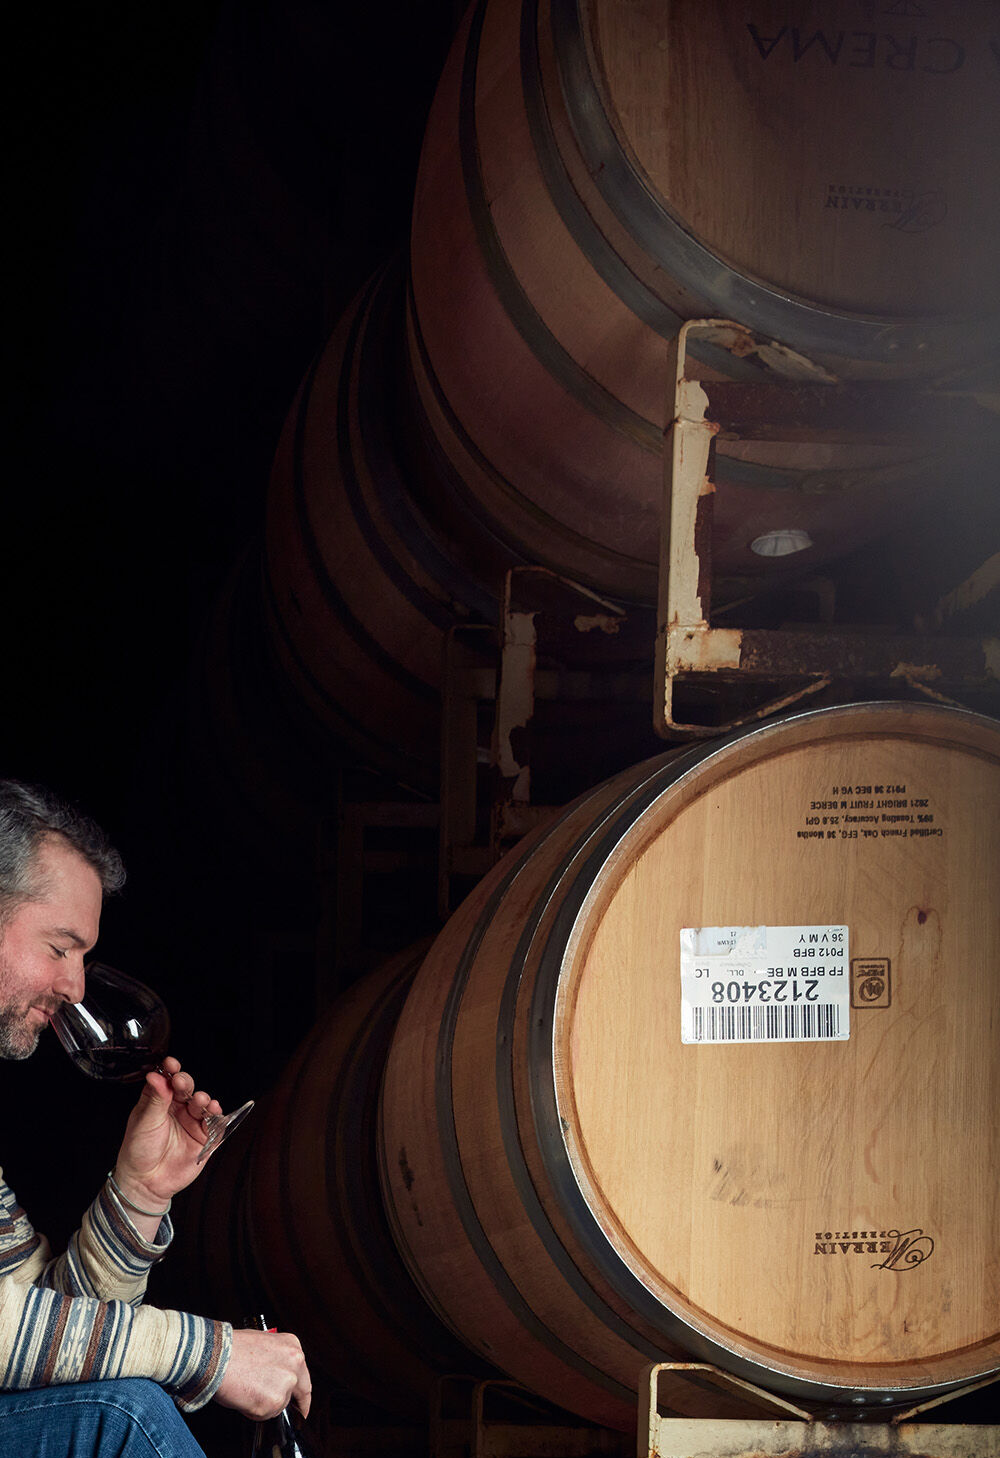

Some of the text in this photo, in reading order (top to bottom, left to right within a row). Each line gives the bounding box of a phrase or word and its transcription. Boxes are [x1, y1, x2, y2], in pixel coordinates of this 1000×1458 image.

[746, 24, 965, 74] CREMA
[833, 787, 838, 795] H
[811, 799, 928, 809] 2021 BRIGHT FRUIT M BERCE
[797, 831, 824, 839] Months
[881, 829, 907, 837] French
[910, 828, 943, 837] Certified
[799, 933, 843, 942] 36 V M Y
[793, 947, 843, 957] P012 BFB
[695, 966, 843, 978] FP BFB M BE LC
[711, 980, 819, 1002] 2123408
[815, 1231, 886, 1239] PRESTIGE
[814, 1229, 934, 1271] MERRAIN
